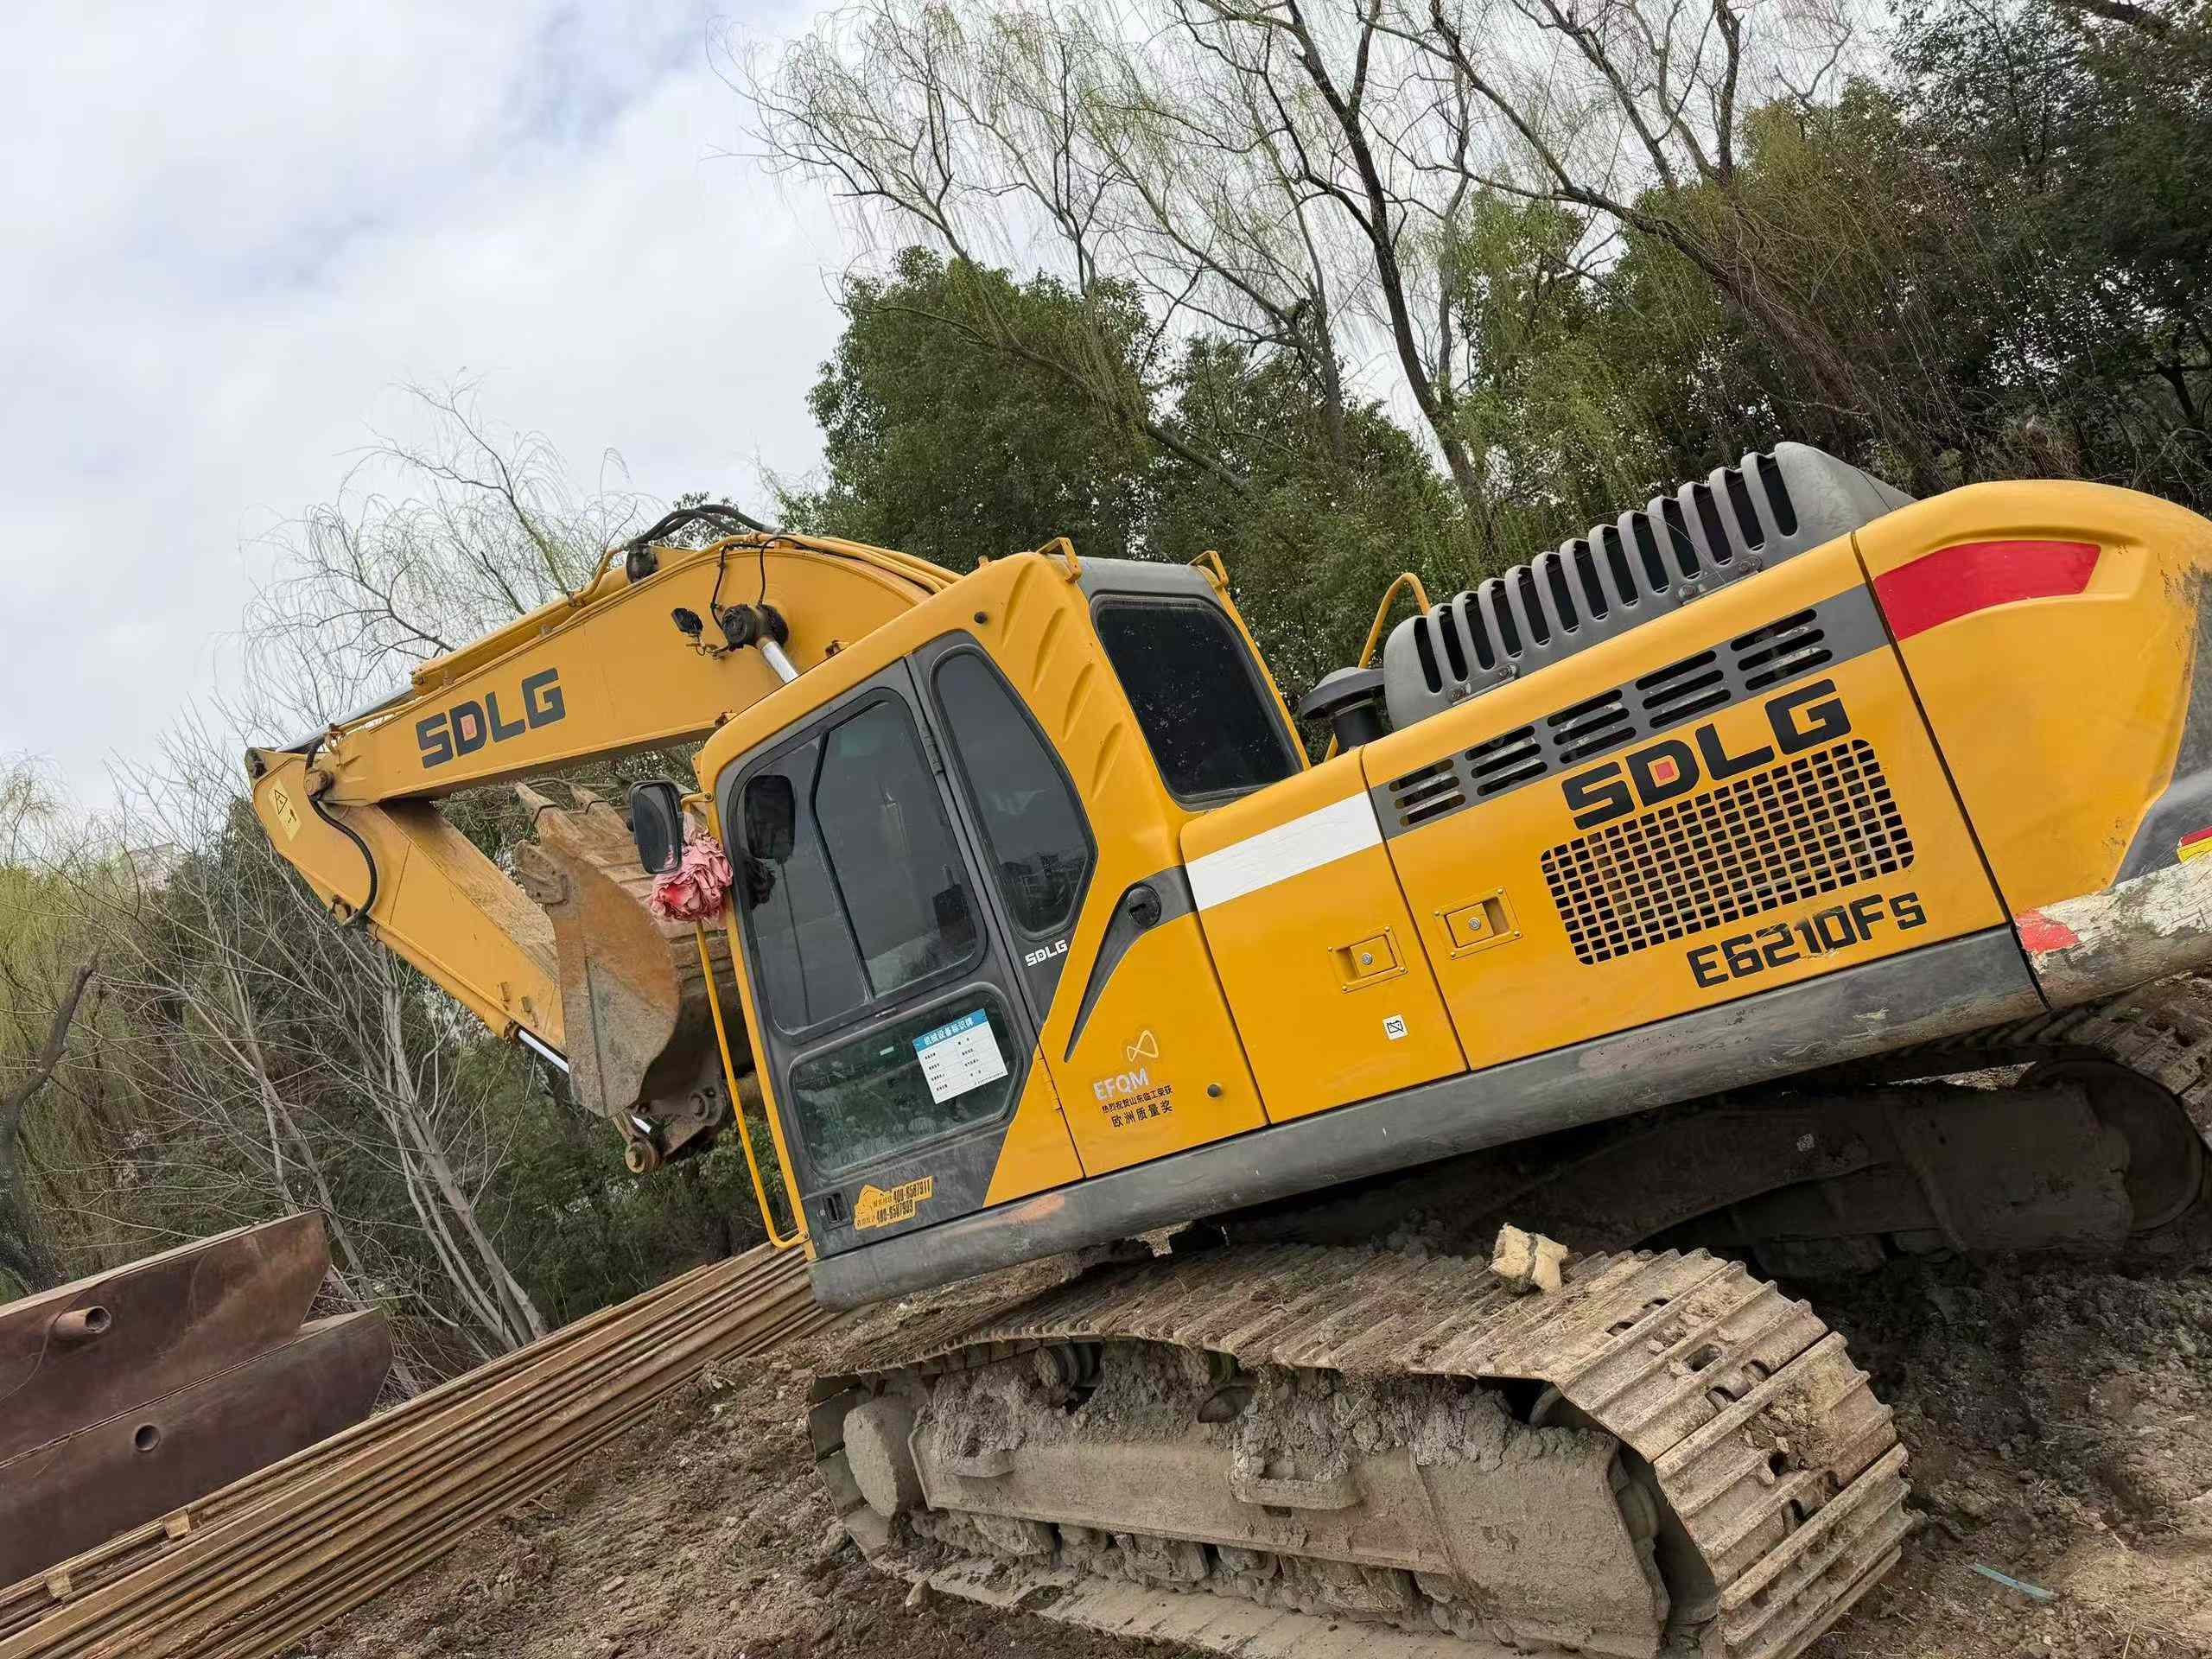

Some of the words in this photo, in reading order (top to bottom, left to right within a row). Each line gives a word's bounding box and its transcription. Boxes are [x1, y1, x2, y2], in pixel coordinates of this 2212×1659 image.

[416, 668, 566, 768] SDLG
[1561, 679, 1852, 830] SDLG
[1025, 940, 1068, 967] SDLG
[923, 1017, 975, 1046] 机械设备标识牌
[1093, 1067, 1149, 1100] EFQM
[1111, 1100, 1173, 1128] 欧洲质量奖
